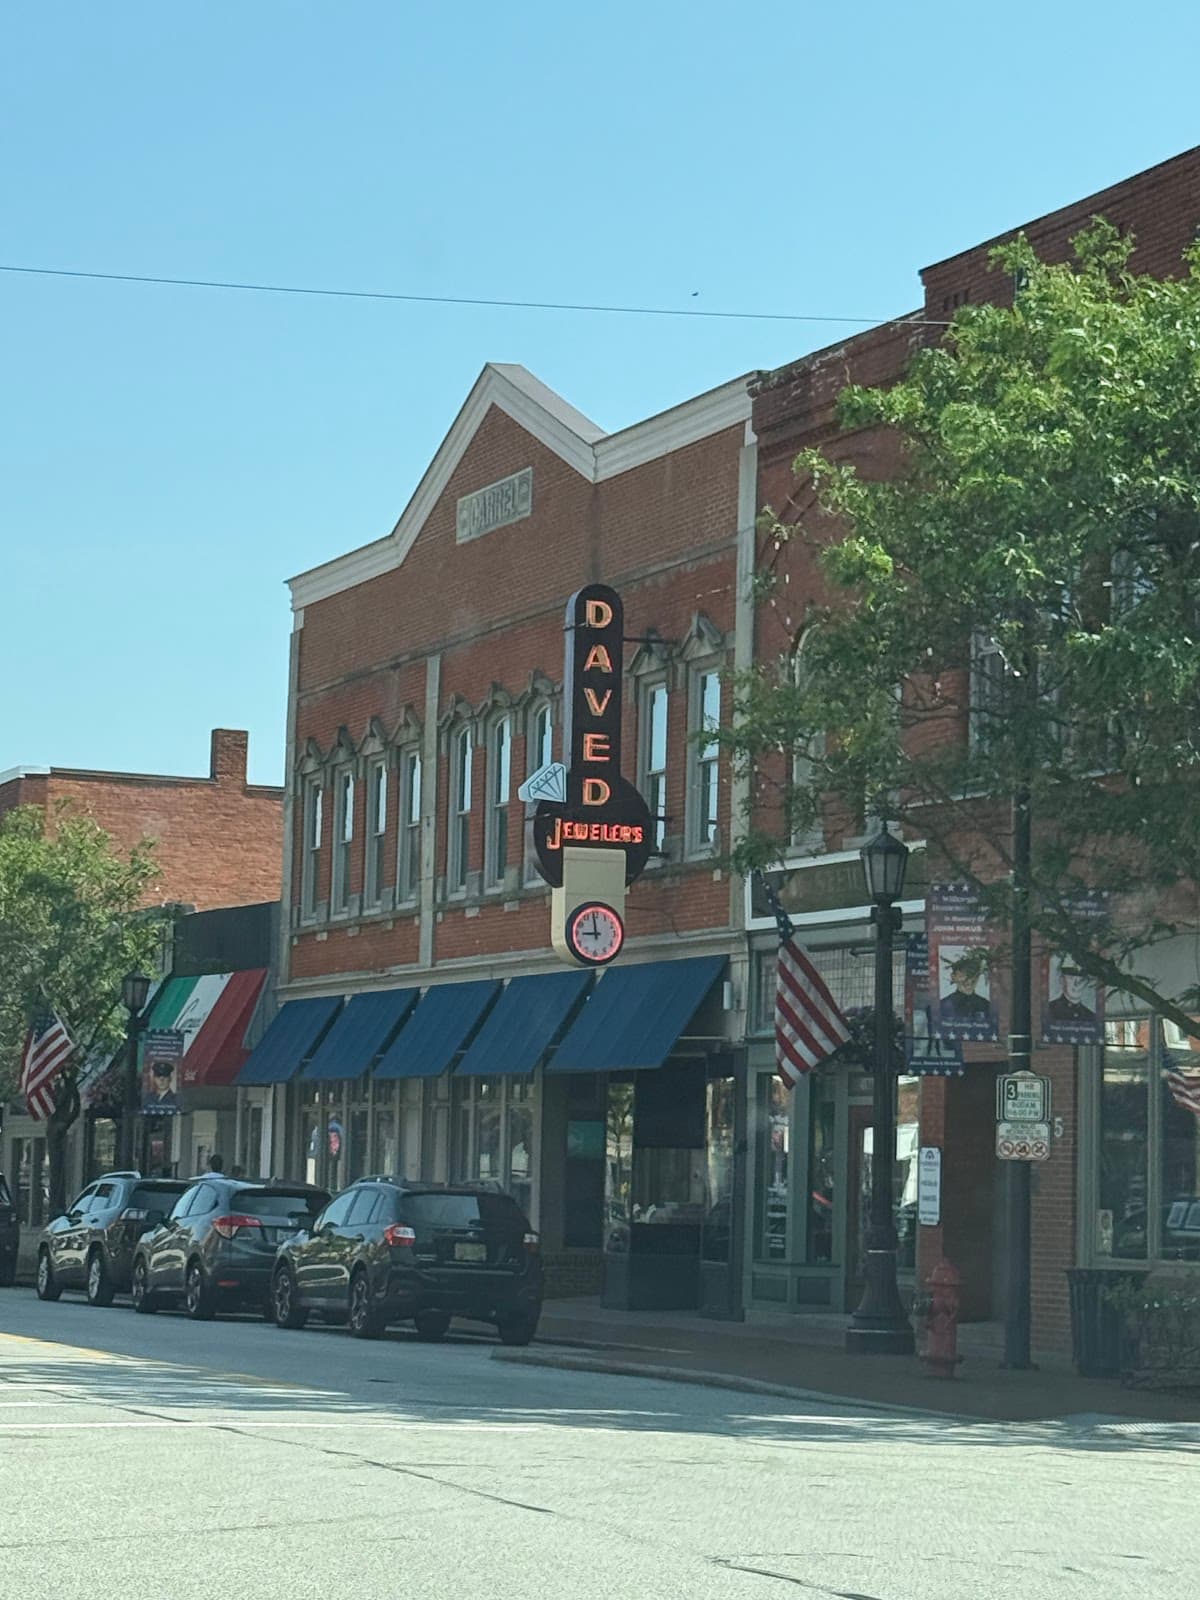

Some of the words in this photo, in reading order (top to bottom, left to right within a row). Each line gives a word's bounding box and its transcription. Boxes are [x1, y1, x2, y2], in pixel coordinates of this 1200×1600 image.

[583, 600, 613, 806] DAVED
[546, 817, 643, 849] JEWELERS
[1007, 1084, 1016, 1099] 3
[1054, 1117, 1064, 1137] 5
